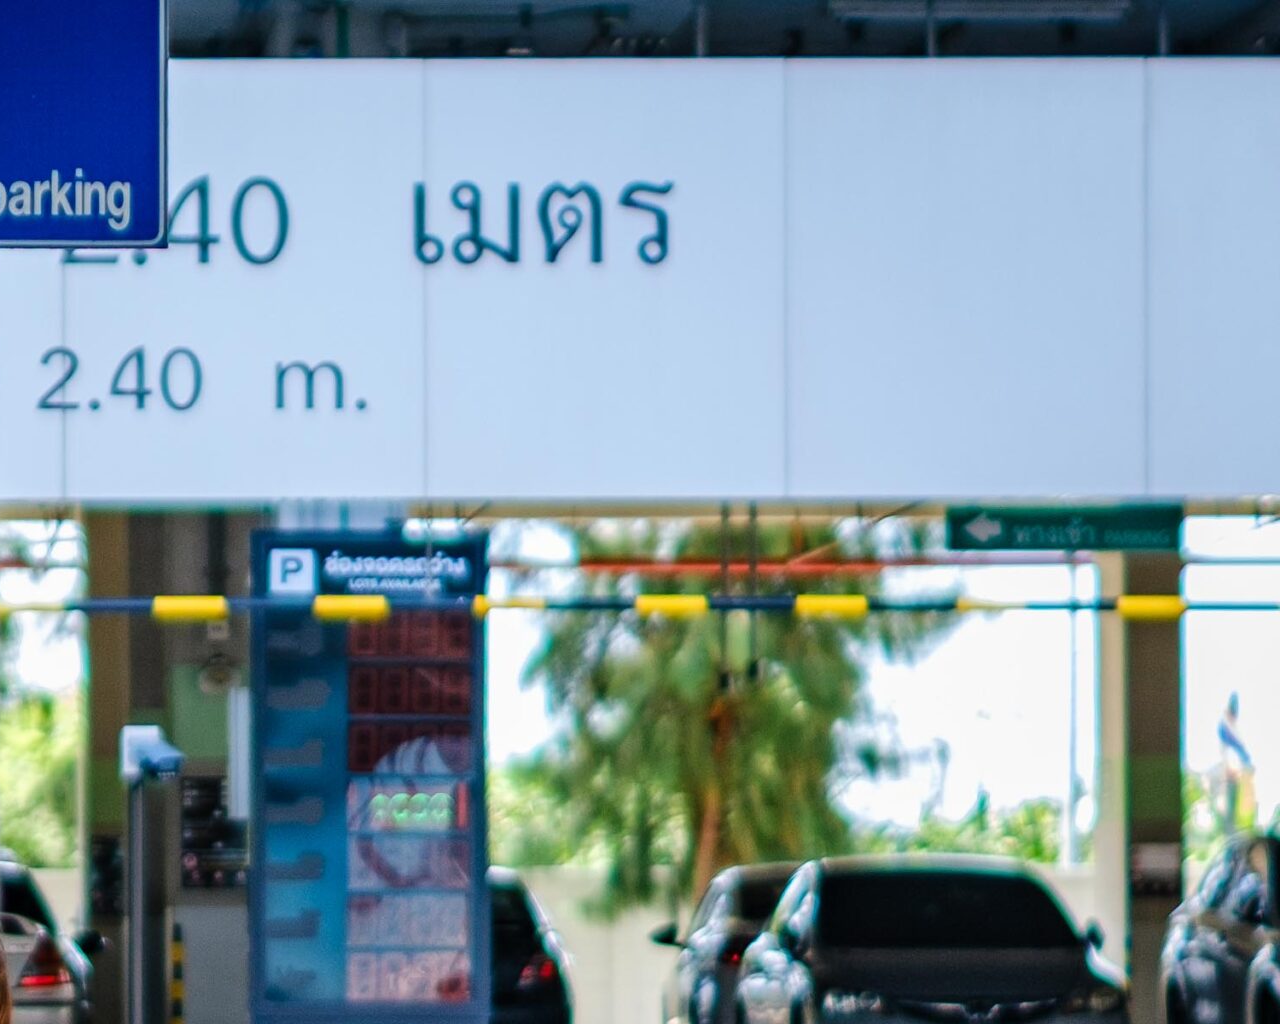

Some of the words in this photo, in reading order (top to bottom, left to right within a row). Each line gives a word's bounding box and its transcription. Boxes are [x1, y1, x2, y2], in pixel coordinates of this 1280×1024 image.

[62, 174, 289, 265] .40
[413, 180, 675, 265] เมตร
[35, 344, 203, 412] 2.40
[274, 359, 368, 411] m.
[280, 557, 303, 583] P
